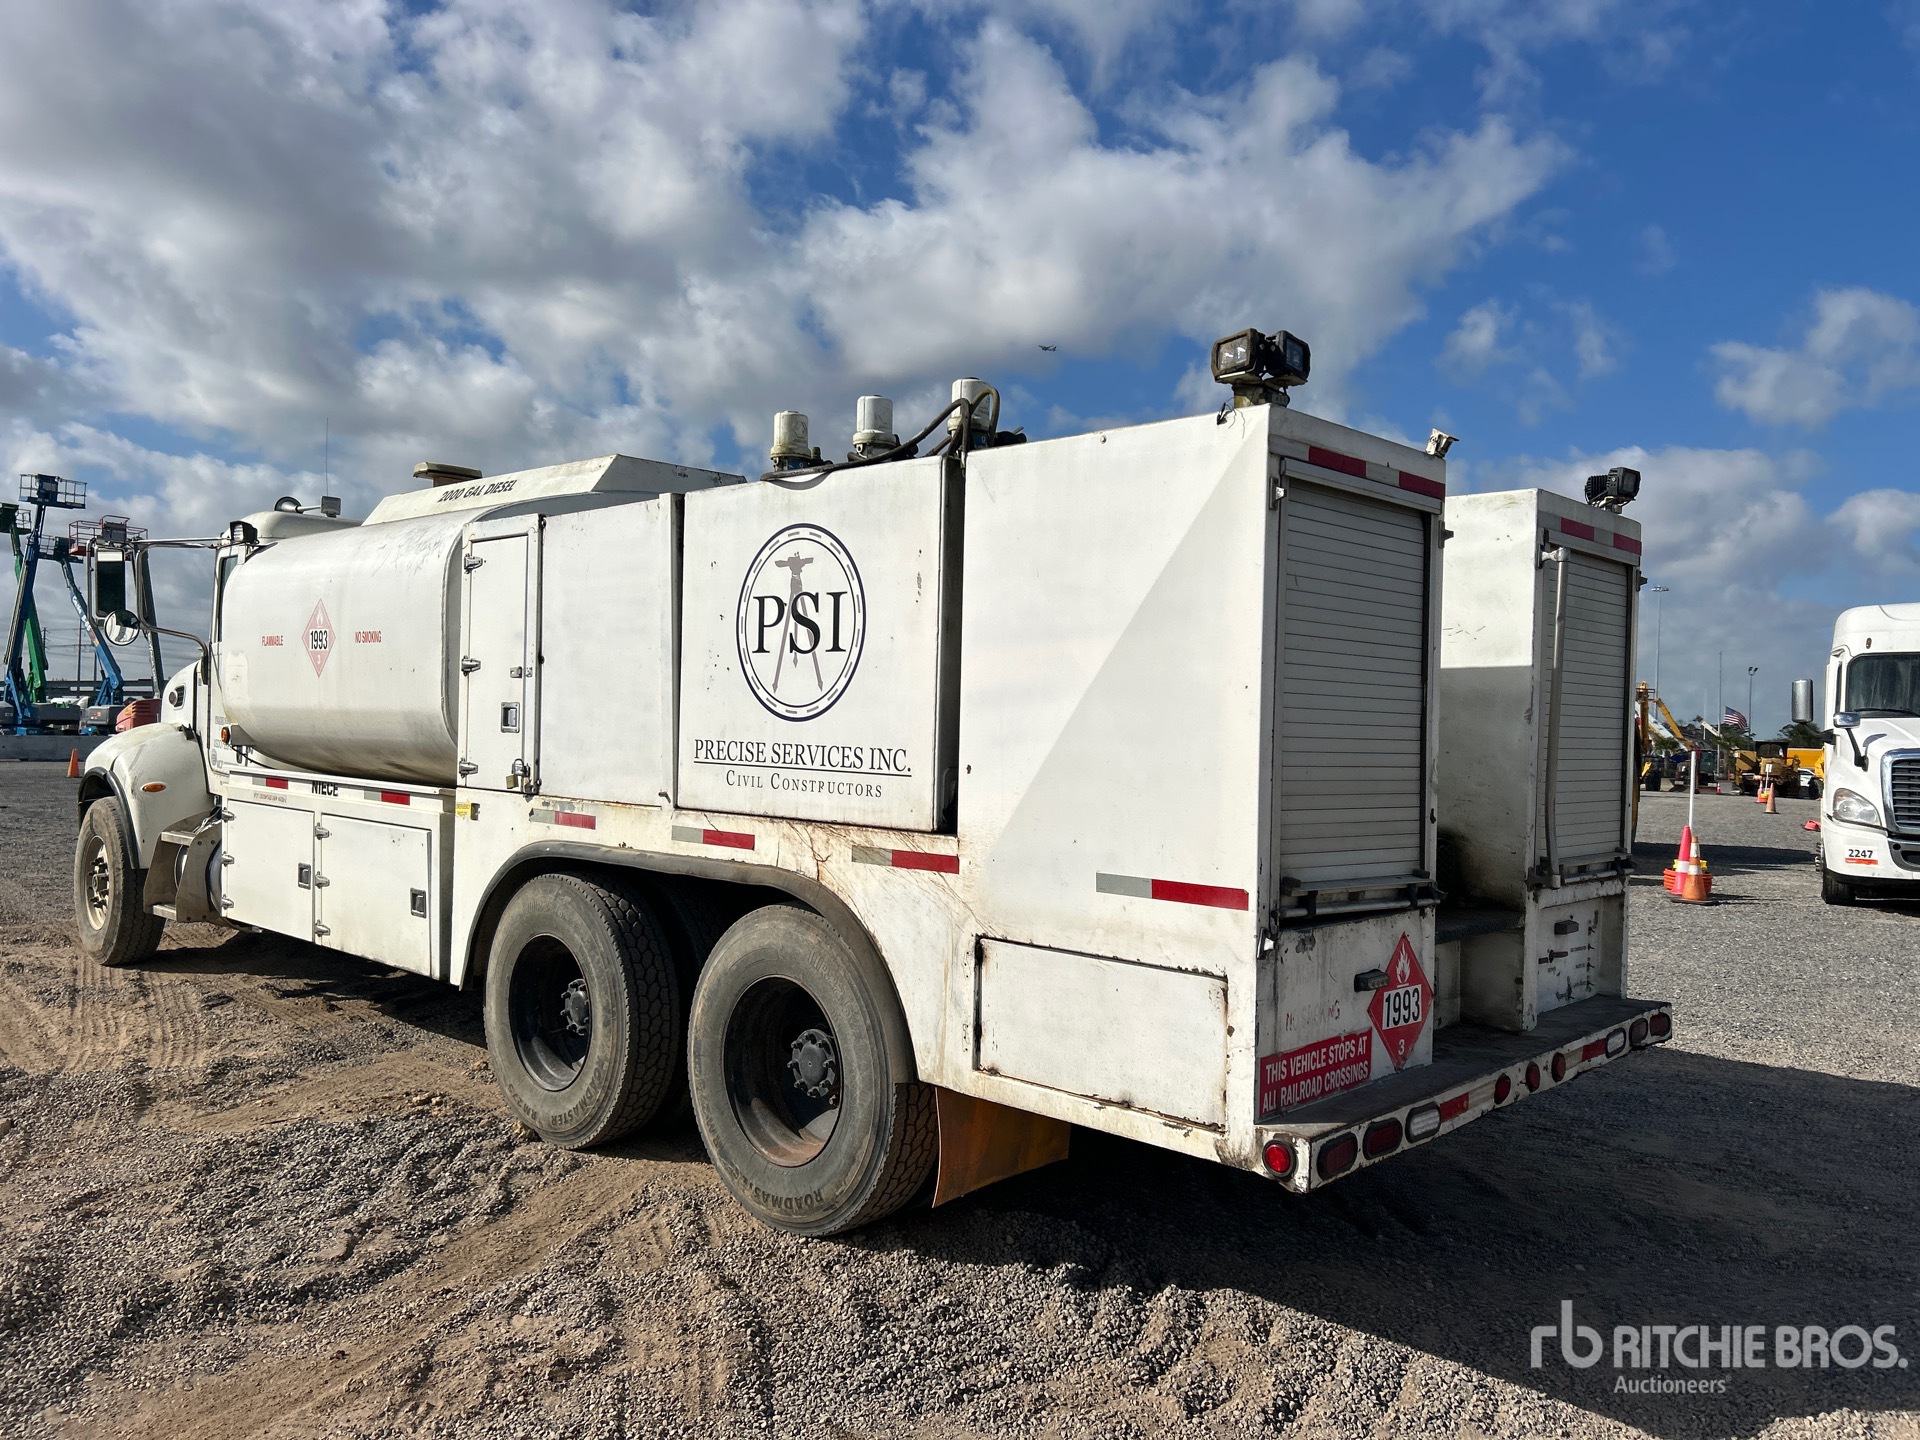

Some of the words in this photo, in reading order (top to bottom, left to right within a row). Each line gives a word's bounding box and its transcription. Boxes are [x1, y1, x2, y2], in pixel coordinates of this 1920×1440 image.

[437, 488, 465, 503] 2000
[463, 484, 486, 499] GAL
[483, 479, 518, 496] DIESEL
[752, 591, 848, 655] PSI
[261, 635, 284, 647] FLAMMABLE
[310, 630, 328, 650] 1993
[354, 631, 362, 644] NO
[361, 630, 382, 644] SMOKING
[694, 738, 767, 763] PRECISE
[770, 743, 864, 770] SERVICES
[868, 747, 912, 772] INC.
[311, 780, 339, 797] NIECE
[1848, 849, 1873, 858] 2247
[1384, 987, 1421, 1028] 1993
[1398, 1038, 1406, 1056] 3
[1265, 1060, 1287, 1085] THIS
[1289, 1051, 1327, 1077] VEHICLE
[1328, 1039, 1356, 1064] STOPS
[1357, 1035, 1368, 1055] AT
[1262, 1090, 1277, 1114] ALL
[1280, 1076, 1323, 1107] RAILROAD
[1324, 1061, 1369, 1091] CROSSINGS
